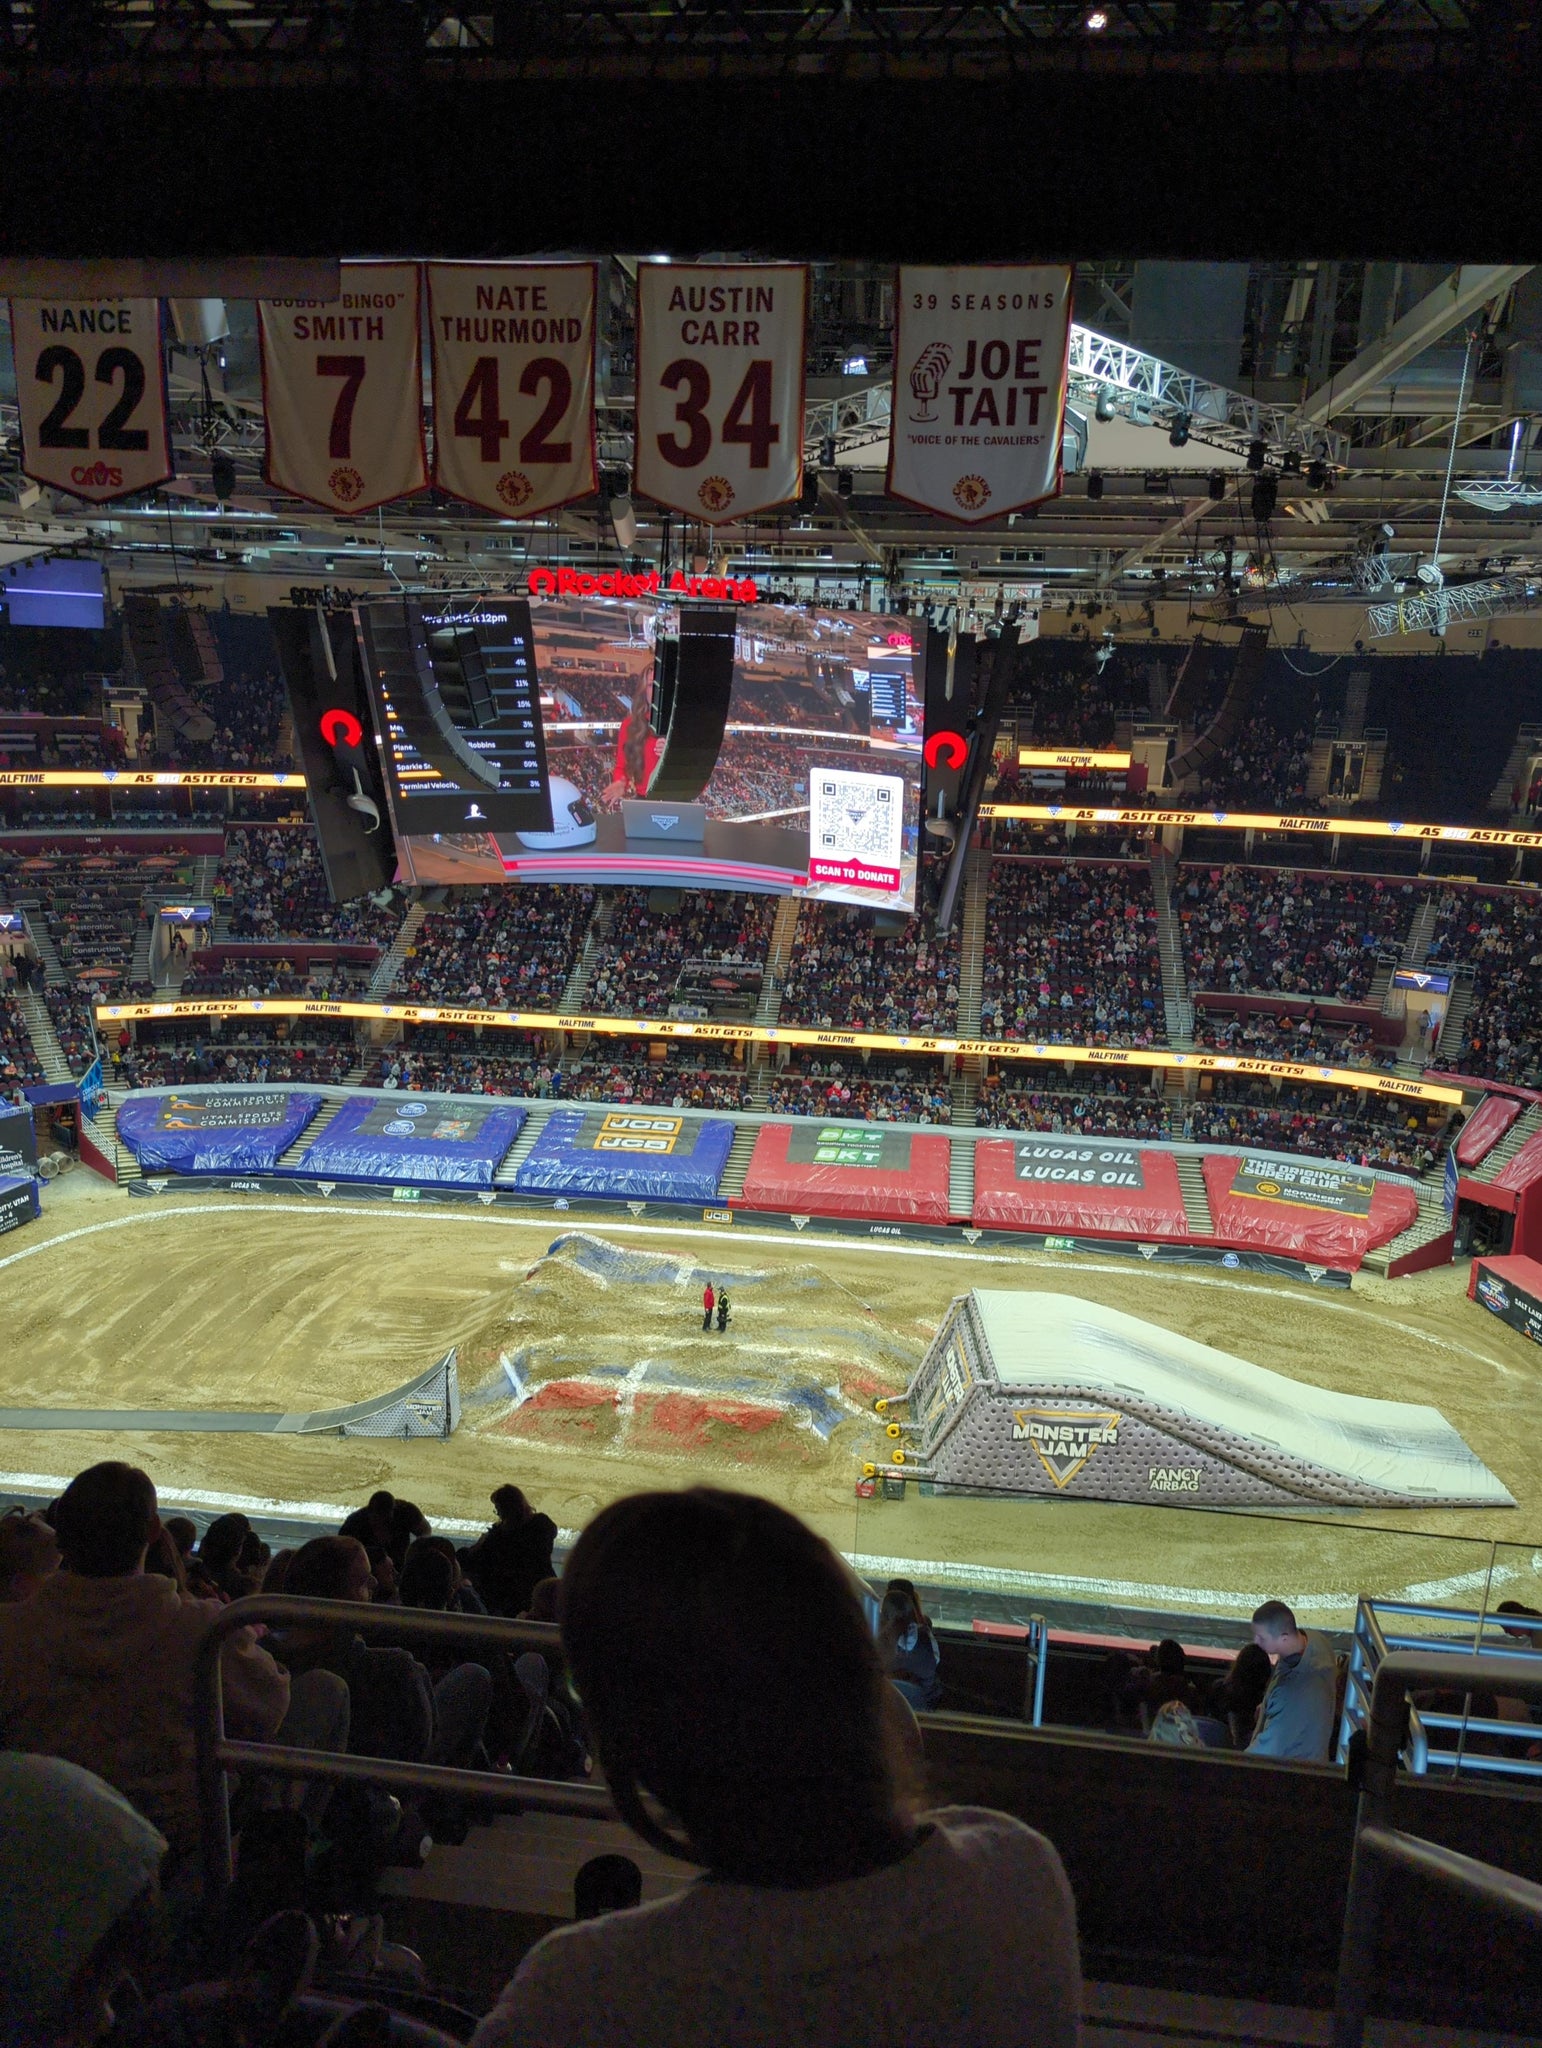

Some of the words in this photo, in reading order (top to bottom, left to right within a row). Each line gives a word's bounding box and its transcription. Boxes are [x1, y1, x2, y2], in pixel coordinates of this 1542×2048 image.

[476, 285, 548, 312] NATE
[668, 285, 774, 313] AUSTIN
[913, 294, 938, 310] 39
[951, 293, 1055, 311] SEASONS
[41, 308, 132, 334] NANCE
[294, 315, 384, 341] SMITH
[440, 316, 583, 344] THURMOND
[681, 319, 761, 346] CARR
[958, 340, 1042, 380] JOE
[36, 345, 149, 451] 22
[317, 355, 365, 459] 7
[454, 356, 572, 464] 42
[948, 386, 1048, 426] TAIT
[656, 358, 780, 469] 34
[945, 435, 958, 445] OF
[960, 435, 980, 446] THE
[557, 567, 659, 597] Rocket
[669, 570, 757, 602] Arena
[481, 614, 507, 624] 12pm
[515, 658, 526, 667] 4%
[515, 679, 529, 687] 11%
[517, 700, 531, 708] 15%
[393, 744, 413, 753] Plane
[1056, 755, 1093, 764] HALFTIME
[397, 763, 422, 772] Sparkle
[135, 775, 153, 783] AS
[182, 774, 200, 783] AS
[202, 774, 216, 783] IT
[219, 774, 257, 784] GETS!
[400, 783, 430, 791] Terminal
[431, 781, 460, 791] Velocity,
[1076, 810, 1093, 818] AS
[1121, 812, 1138, 820] AS
[1140, 812, 1154, 821] IT
[1157, 813, 1196, 823] GETS!
[1279, 818, 1331, 830] HALFTIME
[1420, 827, 1441, 836] AS
[1470, 830, 1491, 840] AS
[1493, 832, 1510, 842] IT
[815, 865, 841, 877] SCAN
[843, 868, 855, 878] TO
[858, 870, 895, 884] DONATE
[72, 945, 122, 954] Construction.
[135, 1007, 151, 1015] AS
[175, 1005, 190, 1013] AS
[192, 1004, 203, 1012] IT
[206, 1004, 237, 1012] GETS!
[305, 1004, 342, 1013] HALFTIME
[404, 1009, 418, 1017] AS
[438, 1011, 452, 1019] AS
[466, 1012, 495, 1021] GETS!
[558, 1019, 596, 1028] HALFTIME
[660, 1025, 674, 1033] AS
[694, 1027, 709, 1035] AS
[710, 1027, 720, 1035] IT
[723, 1028, 753, 1037] GETS!
[817, 1034, 856, 1044] HALFTIME
[921, 1041, 936, 1049] AS
[958, 1044, 973, 1052] AS
[975, 1044, 986, 1052] IT
[989, 1045, 1020, 1054] GETS!
[1088, 1051, 1128, 1061] HALFTIME
[1199, 1058, 1215, 1066] AS
[1238, 1061, 1253, 1069] AS
[1256, 1062, 1268, 1070] IT
[1270, 1063, 1304, 1075] GETS!
[1378, 1079, 1423, 1095] HALFTIME
[242, 1094, 285, 1102] SPORTS
[200, 1117, 281, 1127] COMMISSION
[609, 1118, 675, 1131] JCB
[821, 1131, 882, 1141] BKT
[601, 1137, 668, 1150] JCB
[815, 1150, 880, 1161] BKT
[1019, 1146, 1093, 1161] LUCAS
[1020, 1166, 1096, 1182] LUCAS
[1247, 1159, 1277, 1170] THE
[1278, 1164, 1350, 1184] ORIGINAL
[1244, 1167, 1296, 1182] SUPER
[1300, 1176, 1340, 1190] GLUE
[394, 1189, 420, 1198] BKT
[1284, 1188, 1343, 1203] NORTHERN
[13, 1195, 29, 1206] UTAH
[706, 1212, 730, 1221] JCB
[870, 1226, 890, 1234] LUCAS
[891, 1227, 901, 1235] OIL
[1046, 1237, 1074, 1247] BKT
[1514, 1298, 1527, 1311] SALT
[1013, 1424, 1118, 1444] MONSTER
[1039, 1441, 1088, 1458] JAM
[1149, 1467, 1202, 1481] FANCY
[1149, 1479, 1199, 1491] AIRBAG
